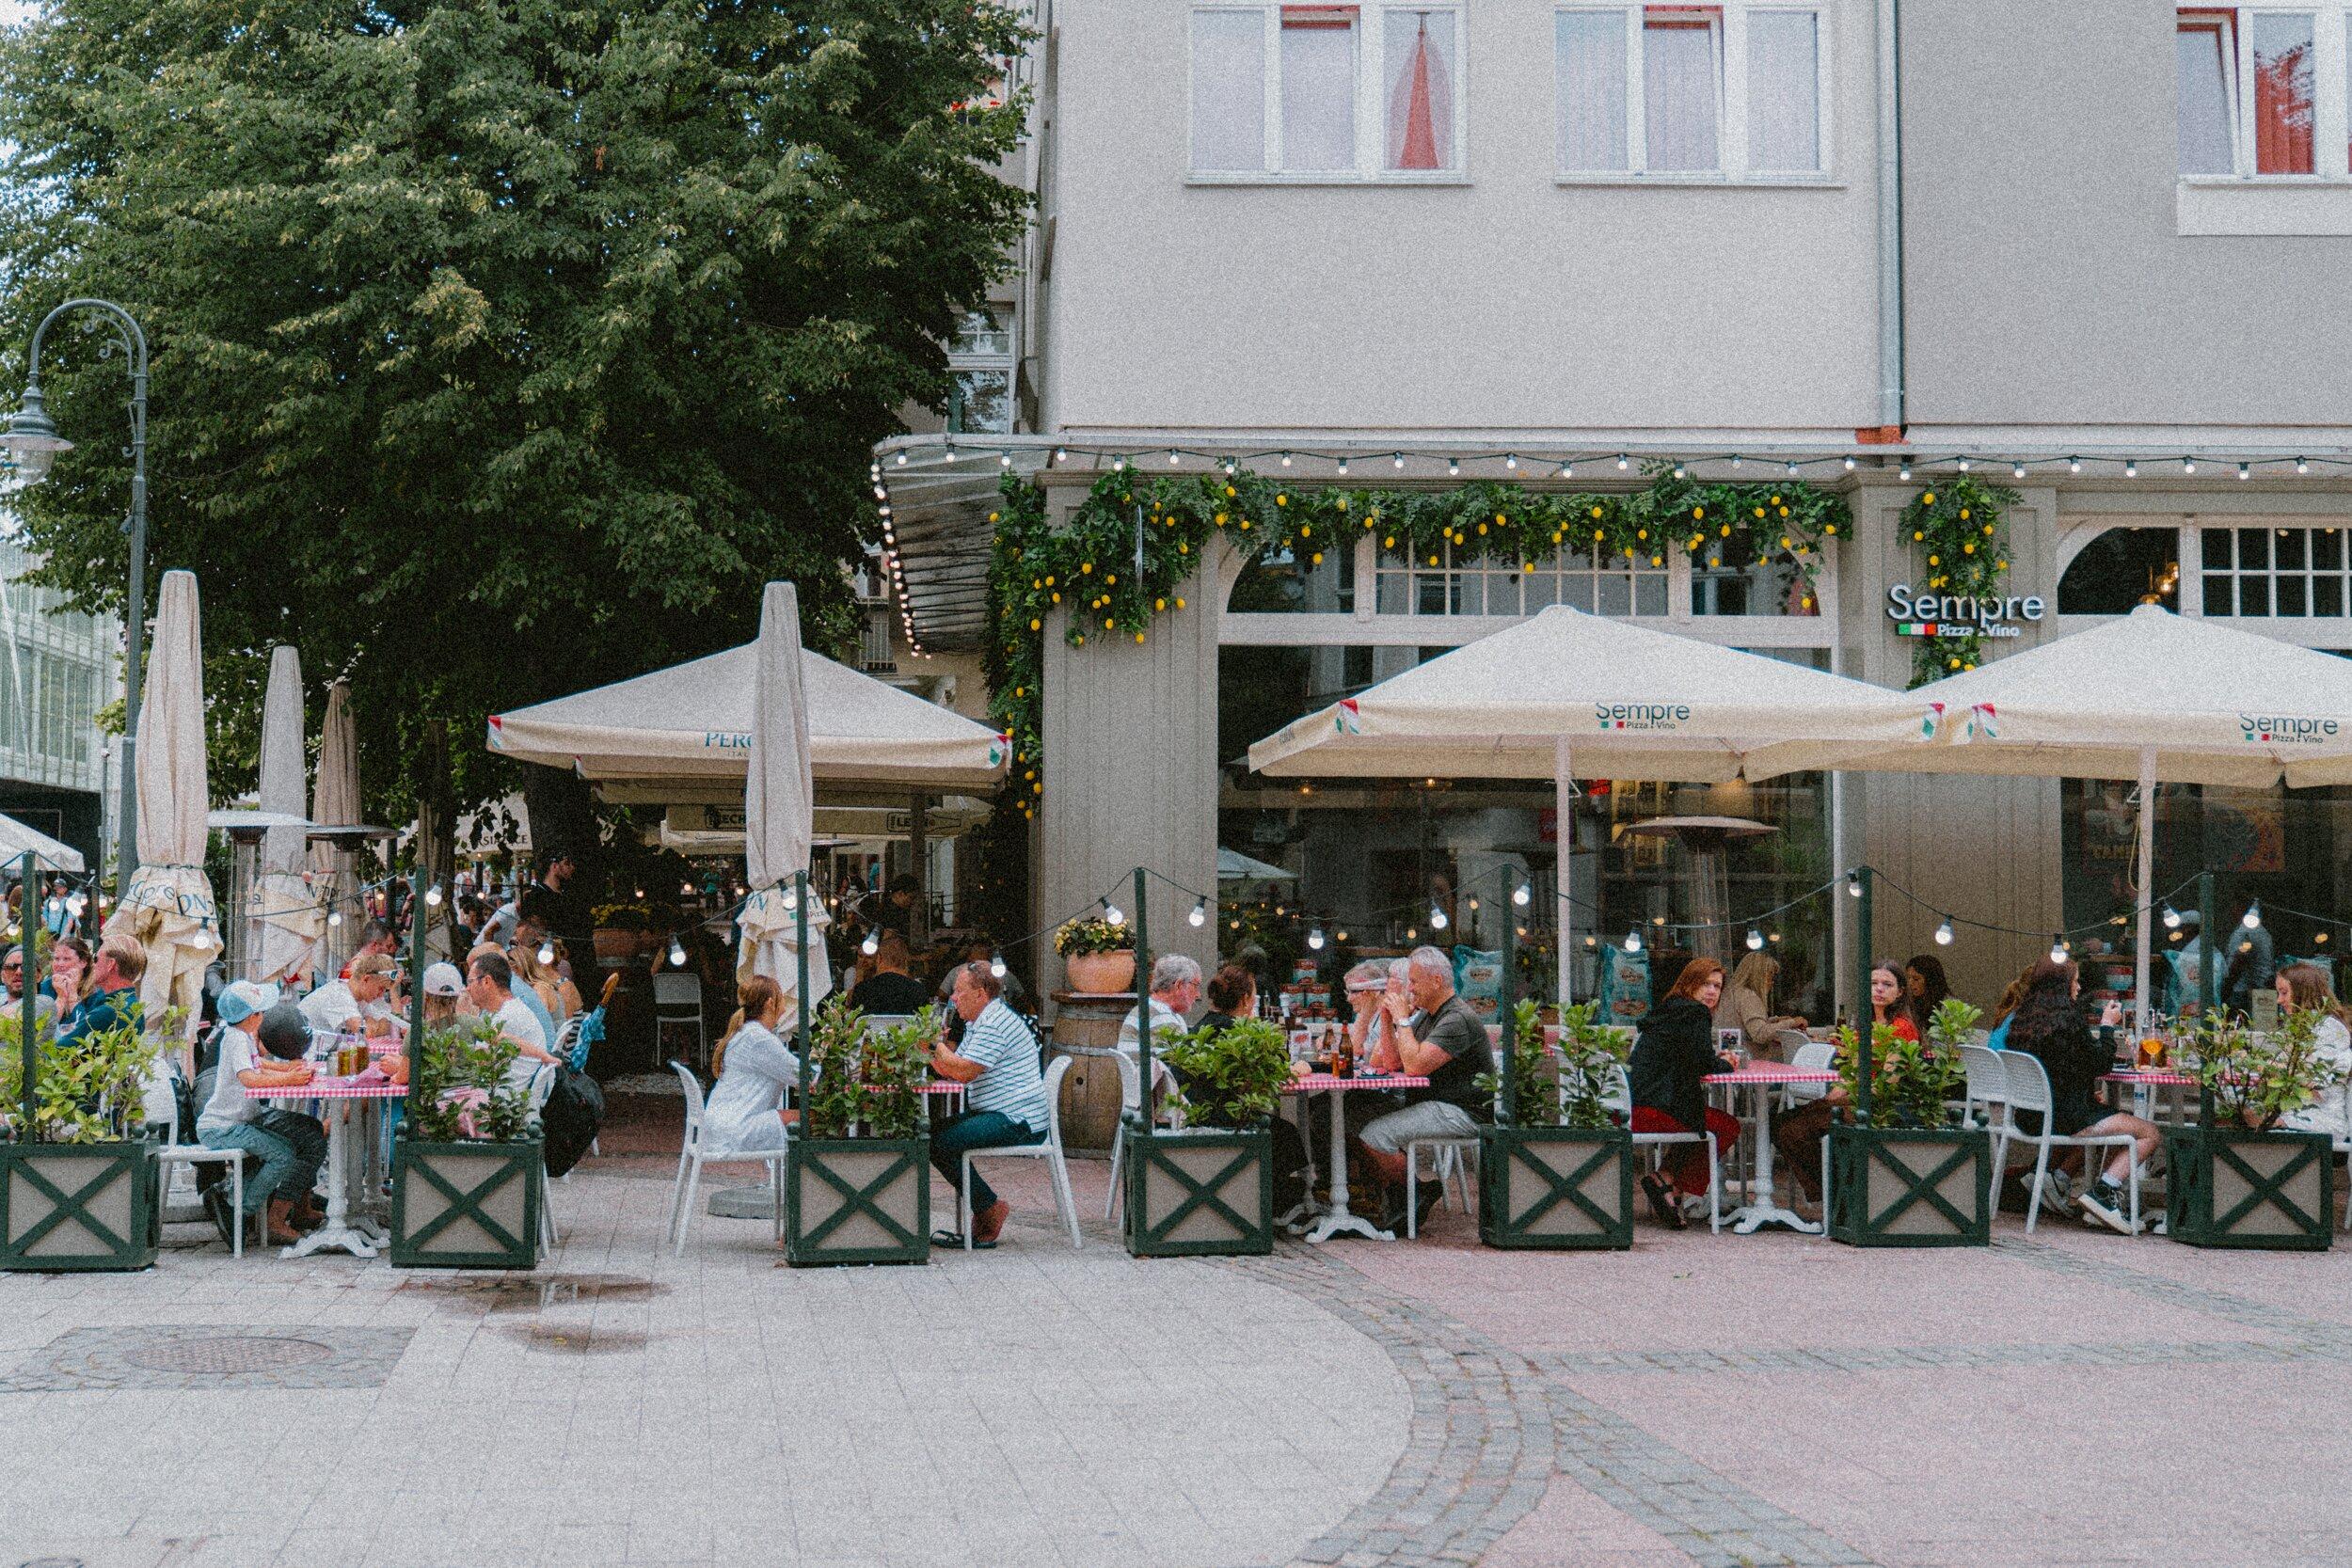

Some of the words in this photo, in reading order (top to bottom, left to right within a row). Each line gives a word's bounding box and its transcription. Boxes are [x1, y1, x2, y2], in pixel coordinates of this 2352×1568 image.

[1887, 584, 2045, 628] Sempre
[1937, 623, 1975, 637] Pizza
[1986, 623, 2021, 637] Vino
[1595, 702, 1691, 725] Sempre
[1627, 721, 1648, 730] Pizza
[1657, 721, 1677, 730] Vino
[2240, 712, 2339, 738] Sempre
[2272, 734, 2296, 743] Pizza
[2303, 735, 2324, 744] Vino
